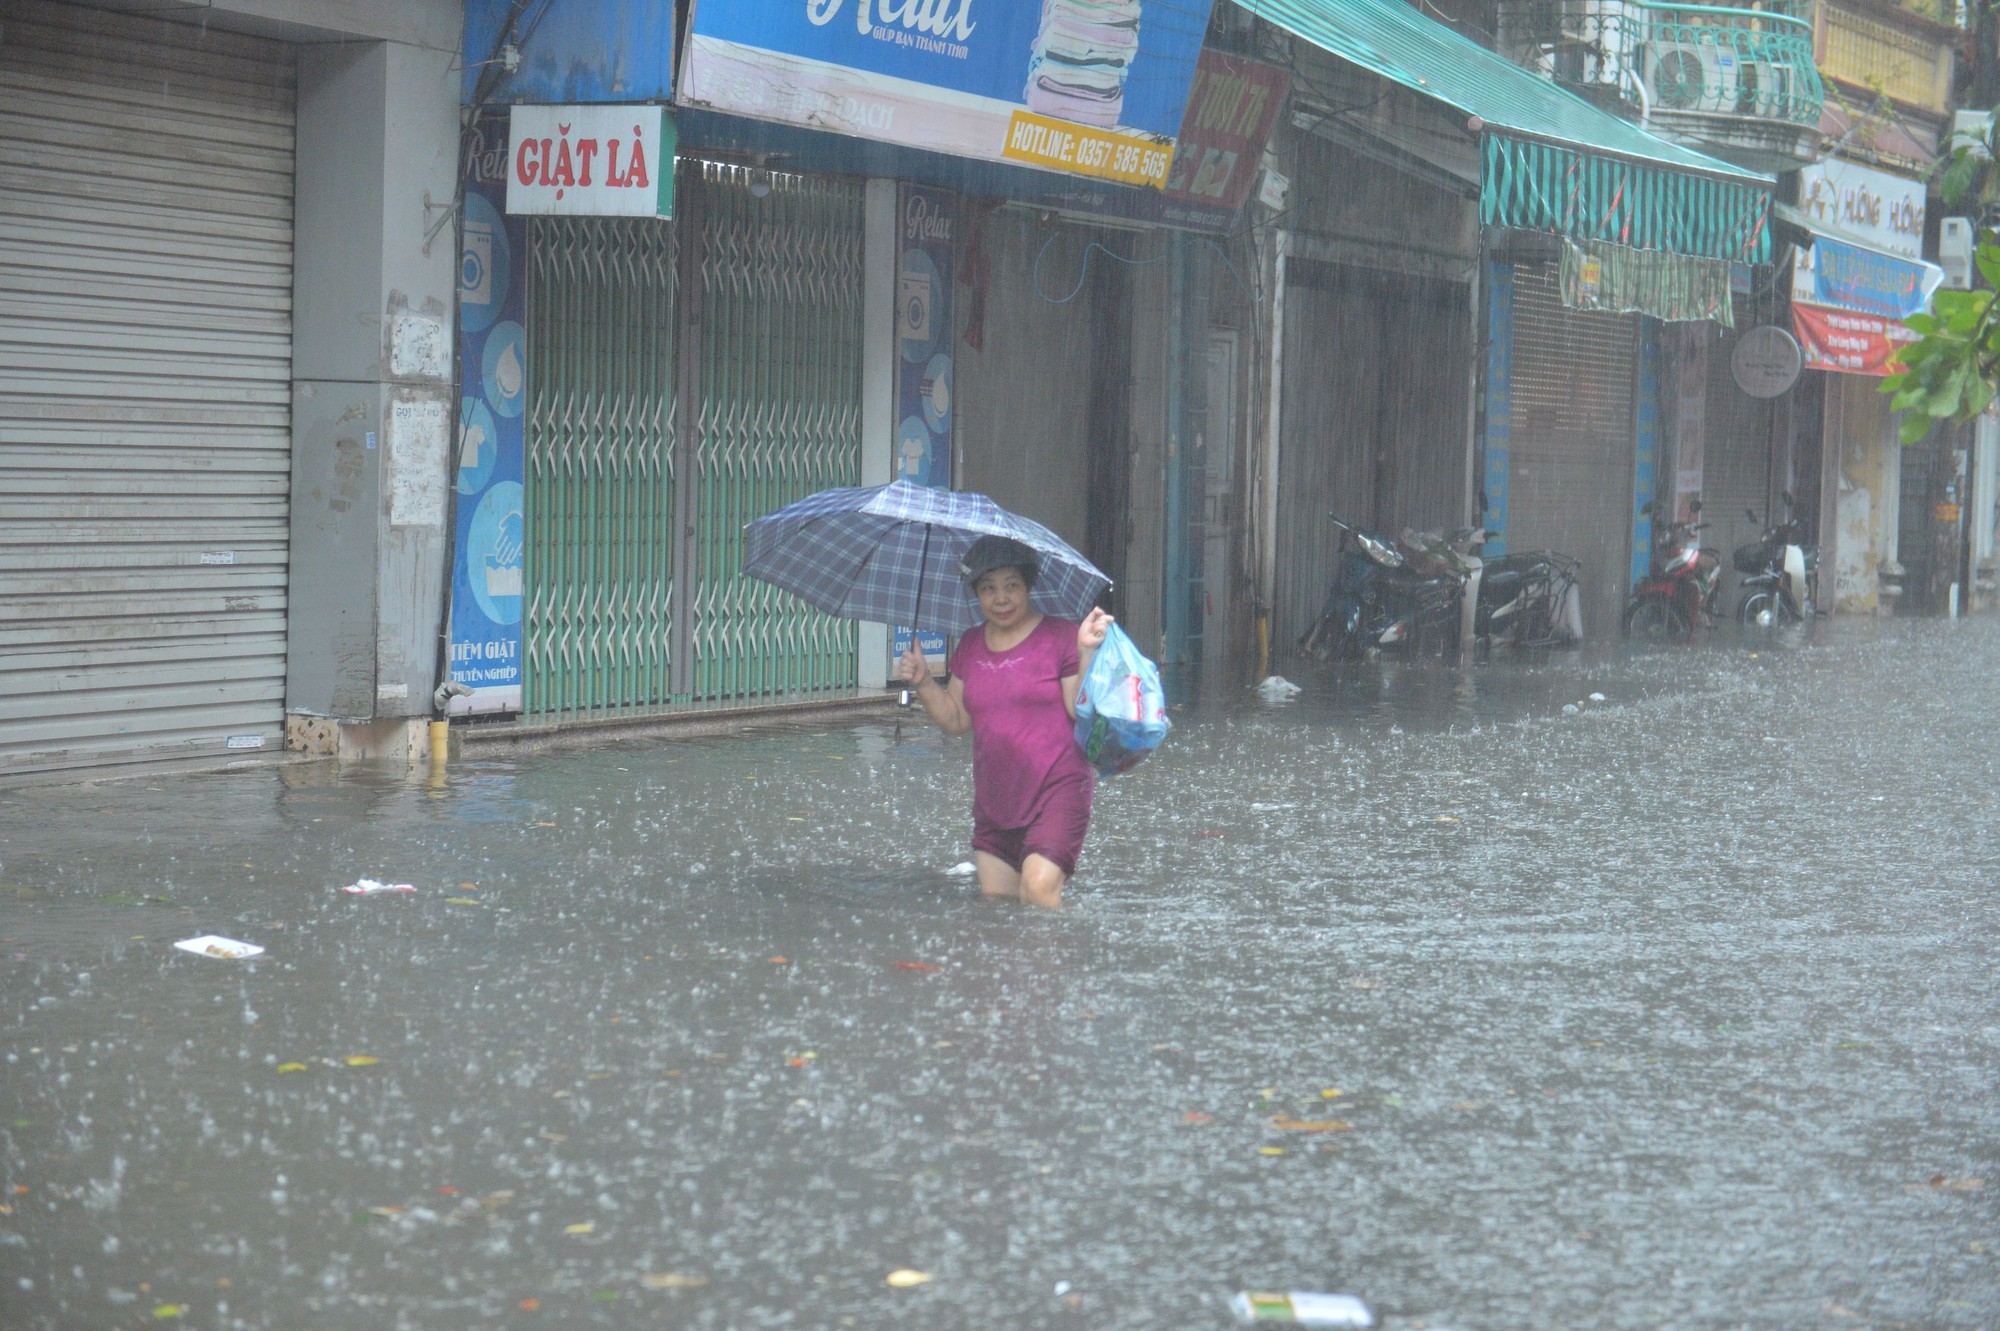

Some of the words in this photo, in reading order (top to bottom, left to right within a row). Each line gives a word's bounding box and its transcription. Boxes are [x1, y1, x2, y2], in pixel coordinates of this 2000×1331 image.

[461, 127, 509, 183] Rela
[516, 122, 598, 201] GIẶT
[605, 124, 650, 188] LÀ
[1010, 120, 1075, 162] HOTLINE:
[1076, 137, 1113, 168] 0357
[1113, 144, 1141, 173] 585
[1140, 149, 1168, 179] 565
[906, 195, 952, 241] Relax
[451, 639, 482, 666] TIỆM
[485, 638, 517, 664] GIẶT
[484, 665, 518, 682] NGHIỆP
